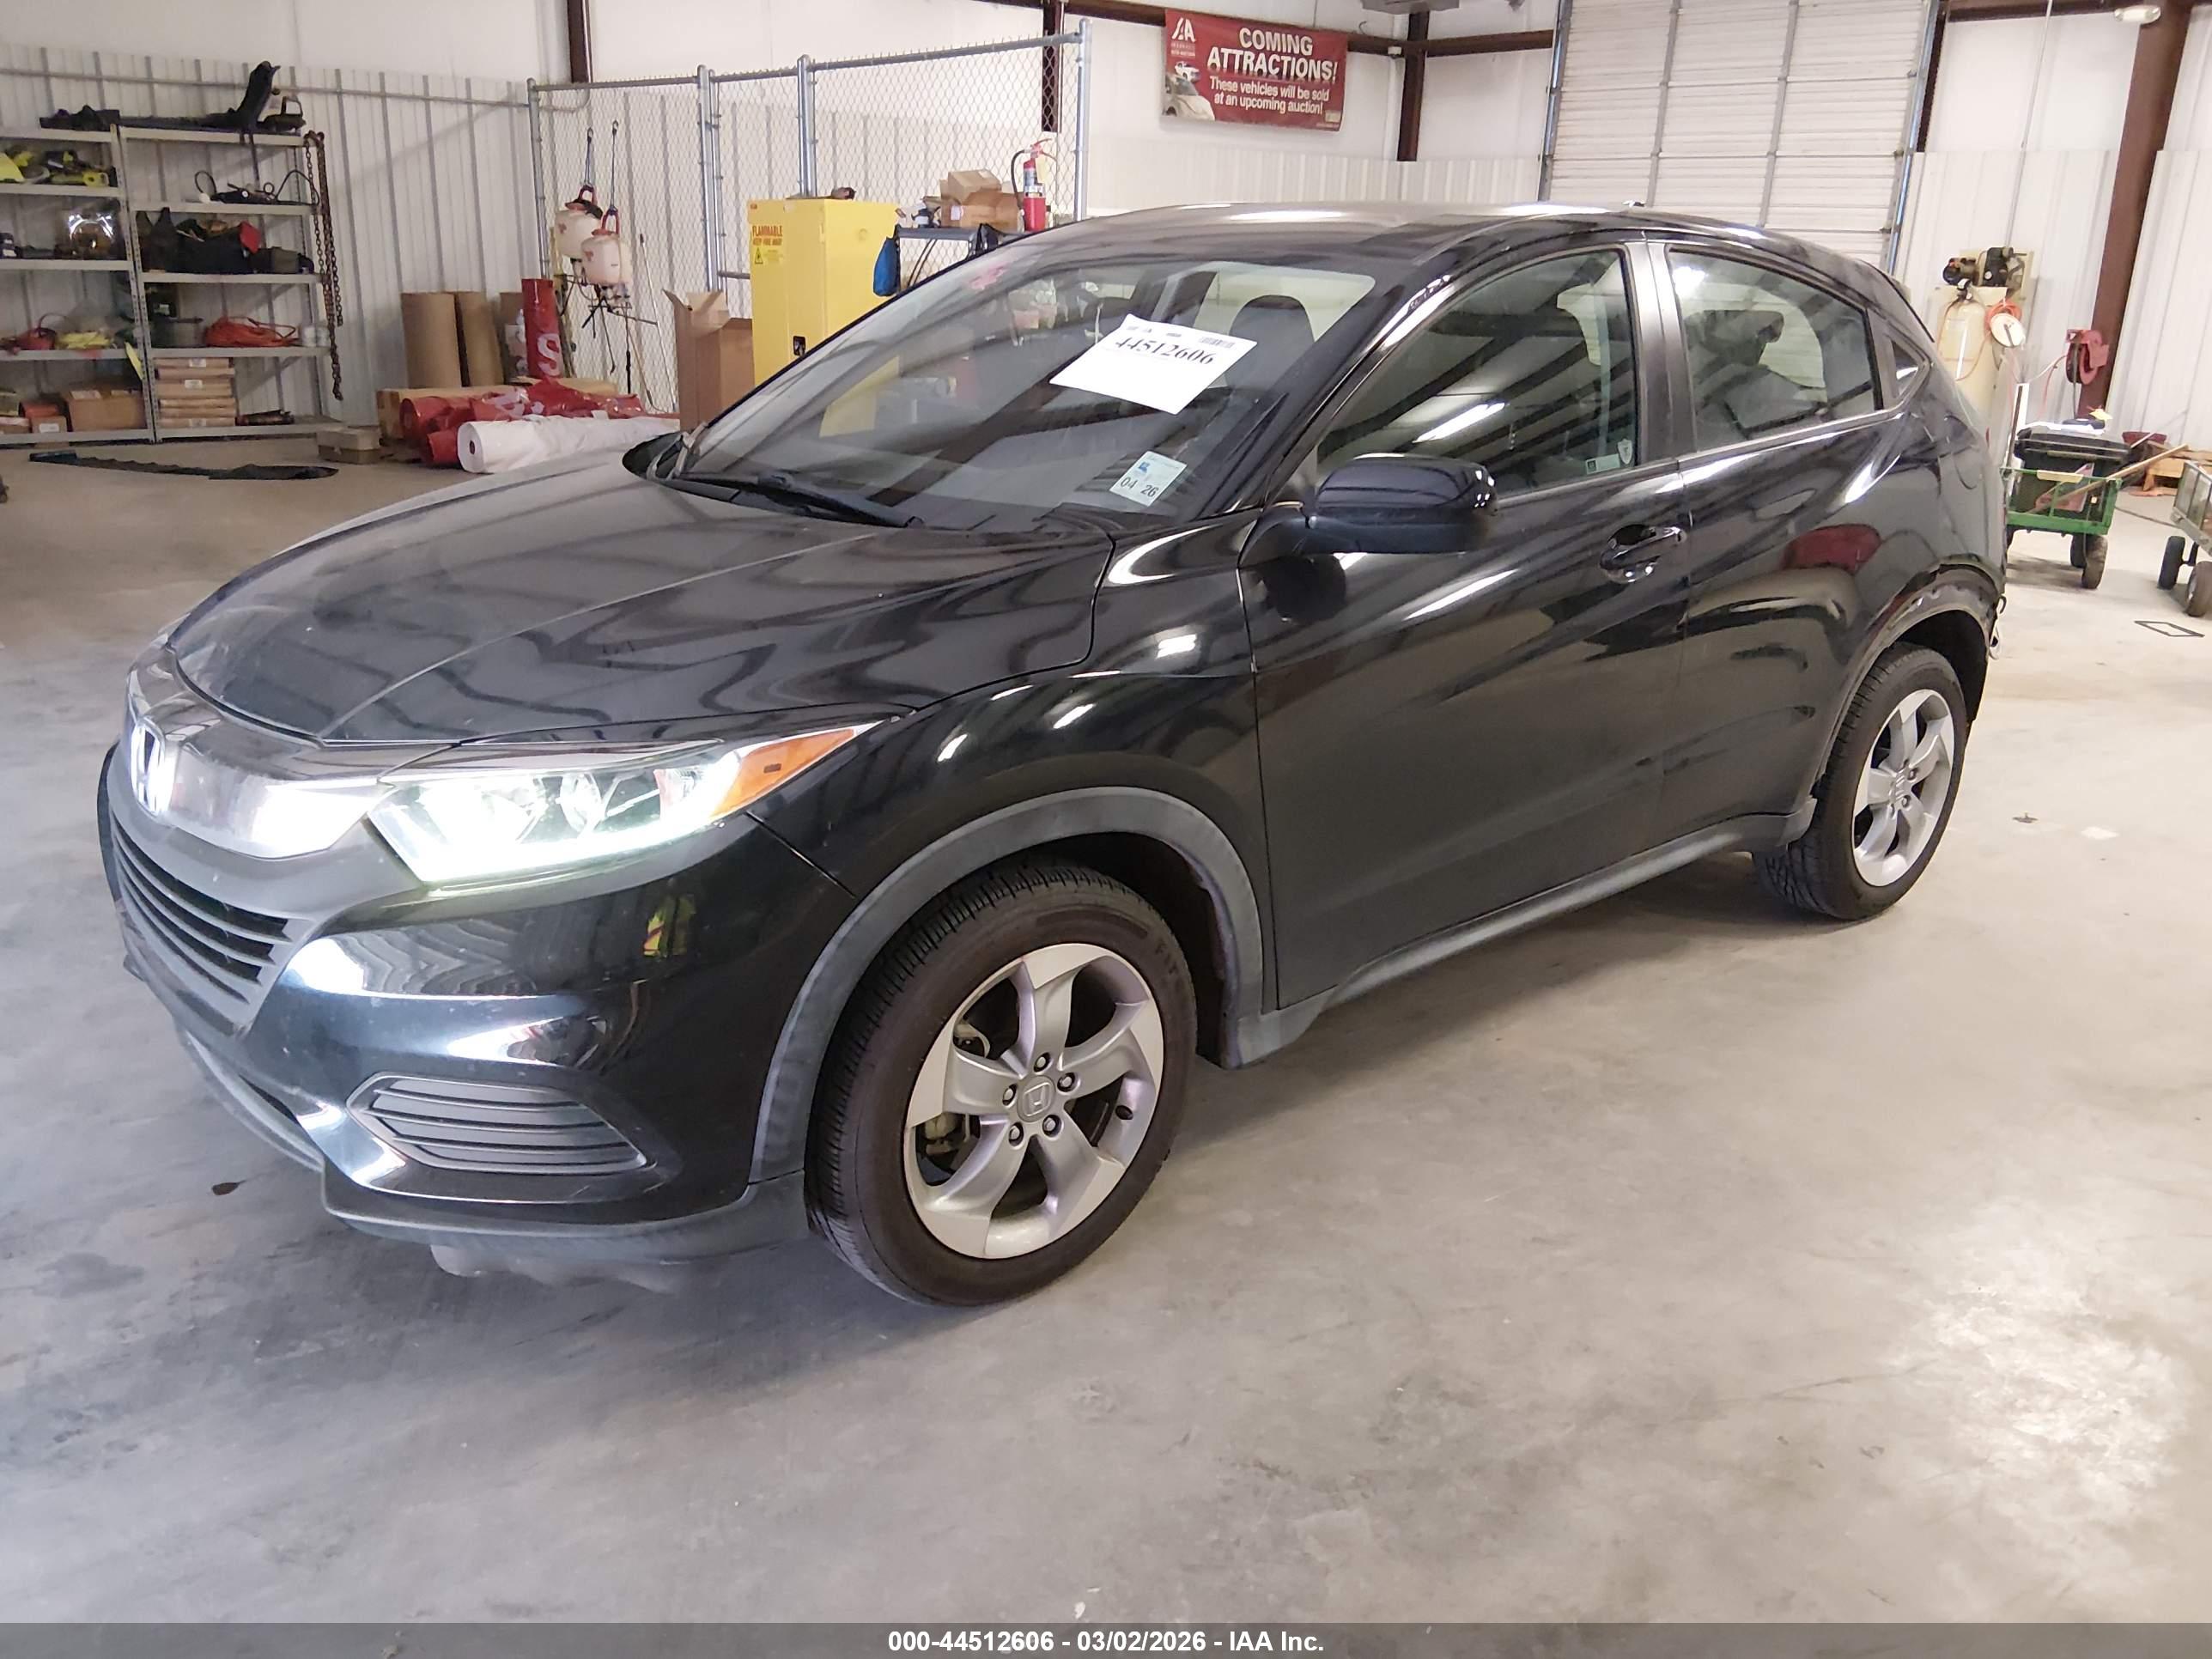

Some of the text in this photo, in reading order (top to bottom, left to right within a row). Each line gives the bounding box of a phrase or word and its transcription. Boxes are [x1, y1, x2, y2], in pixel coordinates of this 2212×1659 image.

[1239, 27, 1314, 57] COMING
[1207, 46, 1338, 81] ATTRACTIONS!
[1209, 76, 1330, 102] These vehicles will be sold
[1213, 92, 1323, 115] at an upcoming auction!
[752, 226, 783, 237] FLAMMABLE
[1115, 336, 1215, 365] 44512606
[1140, 484, 1159, 498] 26
